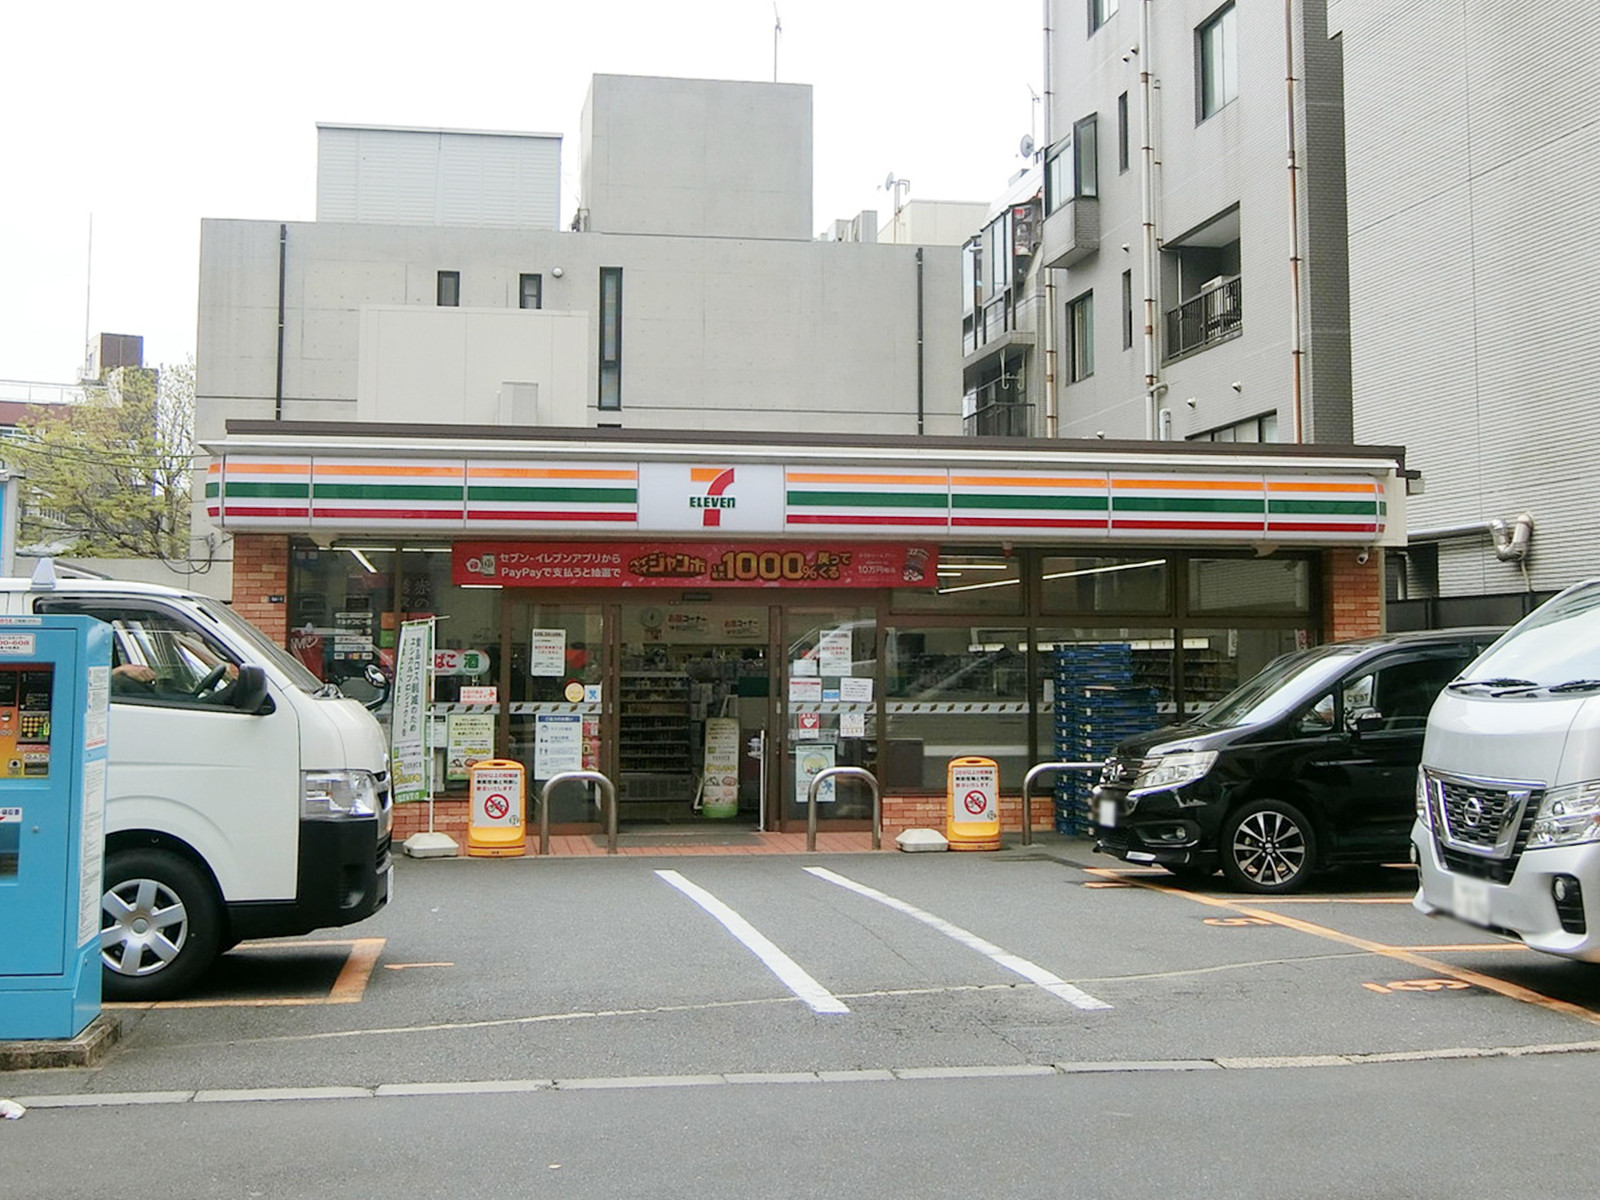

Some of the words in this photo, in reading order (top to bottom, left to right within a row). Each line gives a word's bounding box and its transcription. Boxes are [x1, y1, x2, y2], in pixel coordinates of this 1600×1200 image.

[689, 496, 737, 508] ELEVEN
[690, 467, 735, 527] 7
[434, 653, 457, 669] ばこ
[463, 653, 480, 669] 酒
